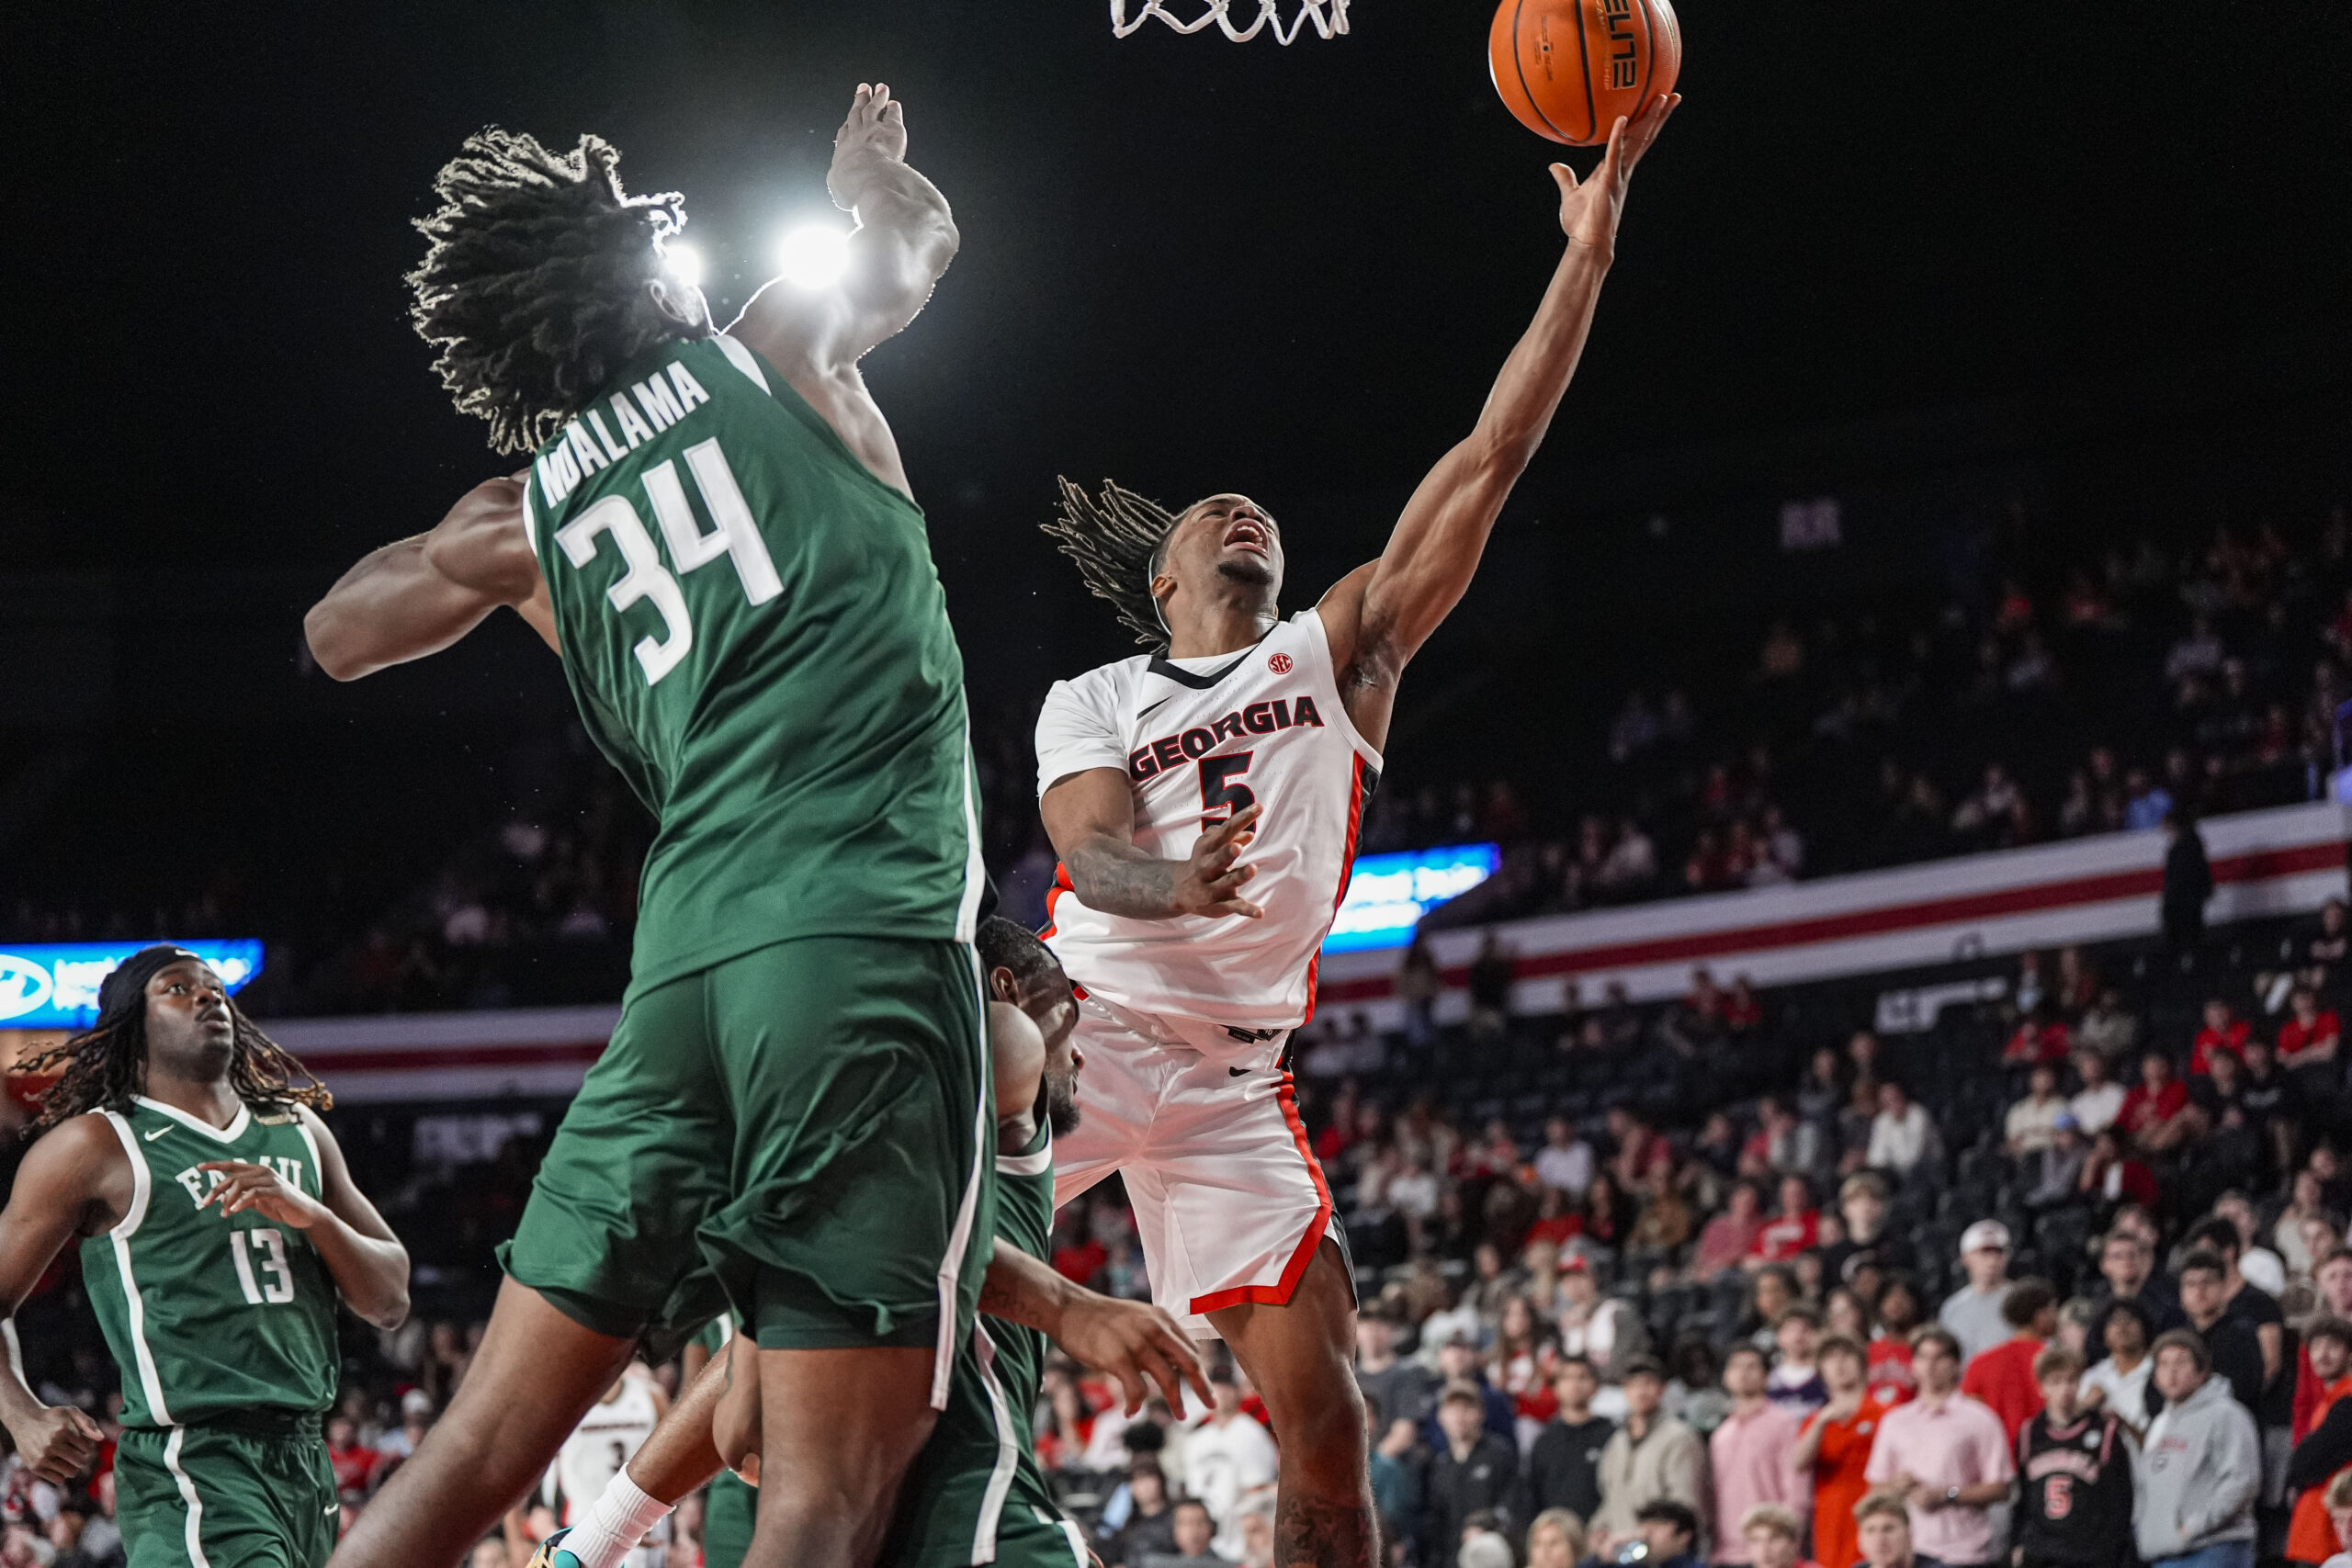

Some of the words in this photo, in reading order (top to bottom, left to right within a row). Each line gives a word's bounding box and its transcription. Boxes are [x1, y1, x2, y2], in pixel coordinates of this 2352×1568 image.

[554, 436, 784, 686] 34
[1270, 654, 1291, 672] SEC
[1129, 696, 1324, 781] GEORGIA
[1198, 750, 1256, 833] 5
[175, 1156, 302, 1211] FAU
[231, 1228, 294, 1304] 13
[2045, 1476, 2073, 1519] 5
